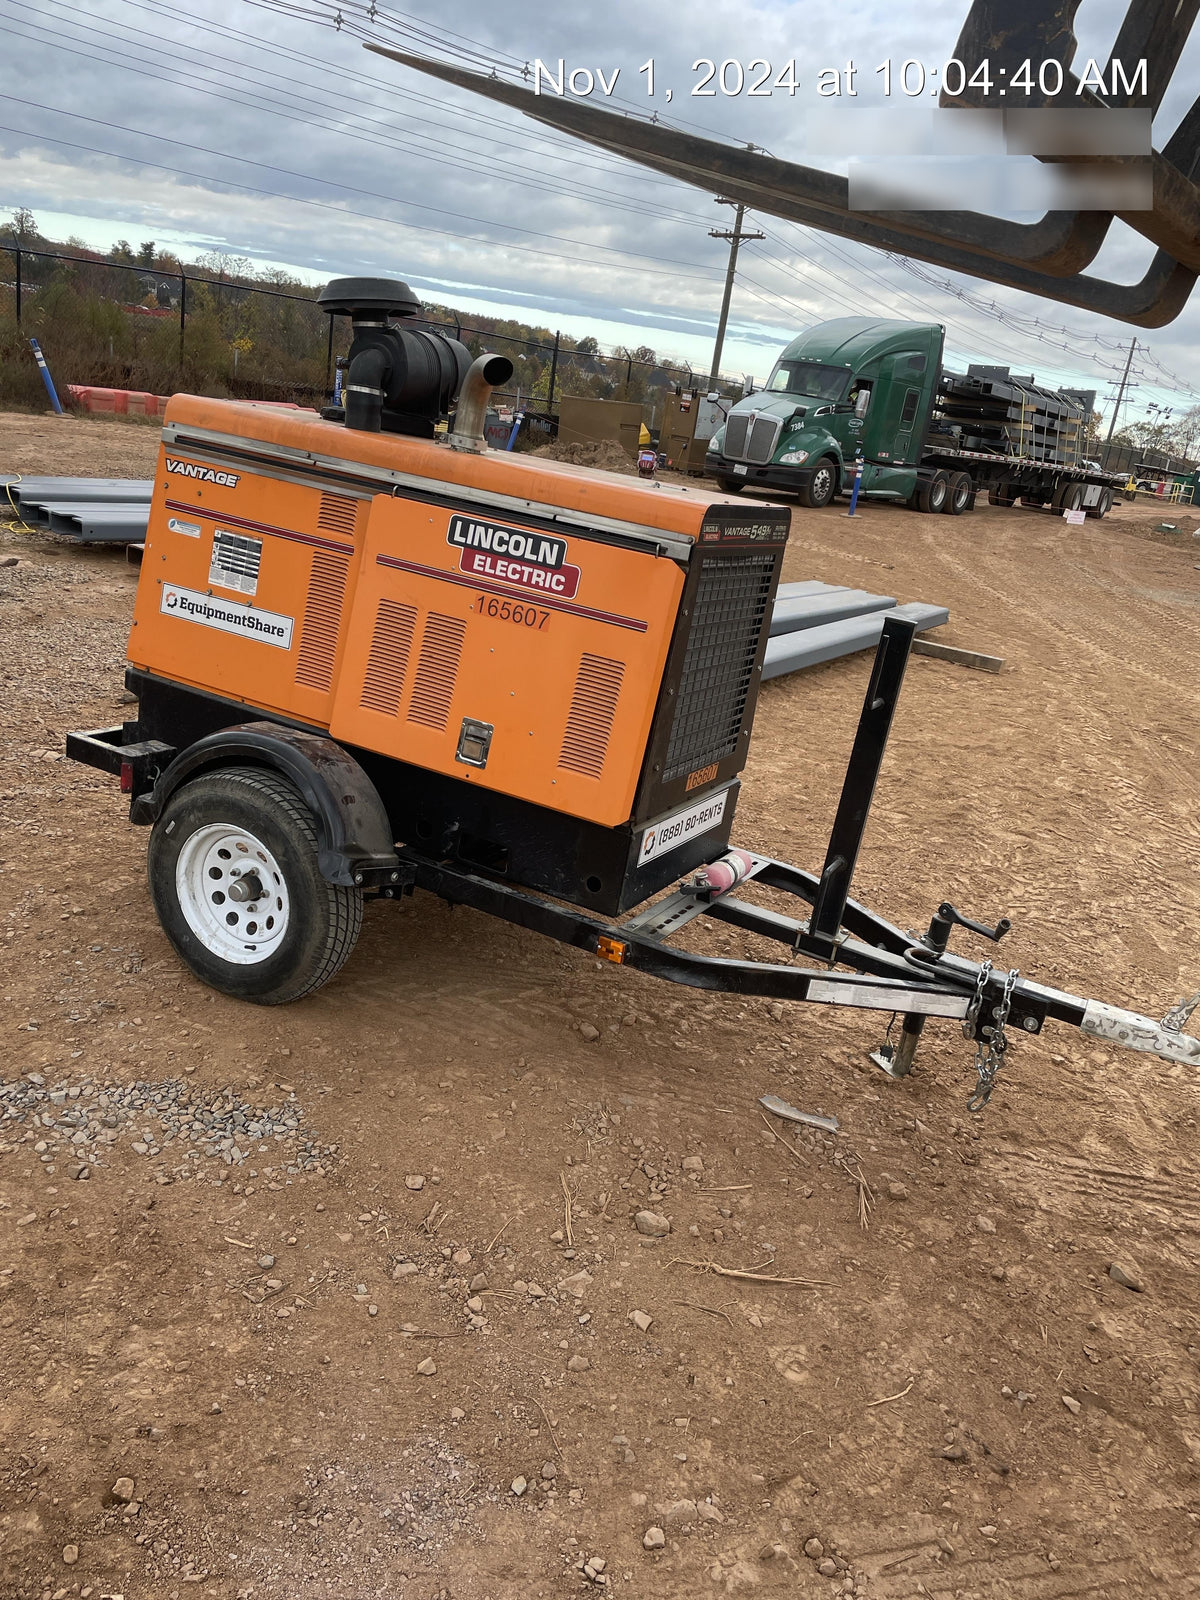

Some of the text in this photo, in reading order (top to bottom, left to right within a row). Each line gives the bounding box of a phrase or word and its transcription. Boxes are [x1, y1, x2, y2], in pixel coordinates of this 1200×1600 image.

[166, 458, 240, 488] VANTAGE
[453, 520, 559, 566] LINCOLN
[724, 527, 751, 536] VANTAGE
[473, 554, 566, 591] ELECTRIC
[179, 596, 285, 638] EquipmentShare
[478, 595, 551, 630] 165607
[687, 763, 718, 790] 165607
[658, 802, 723, 845] (888) 80-RENTS
